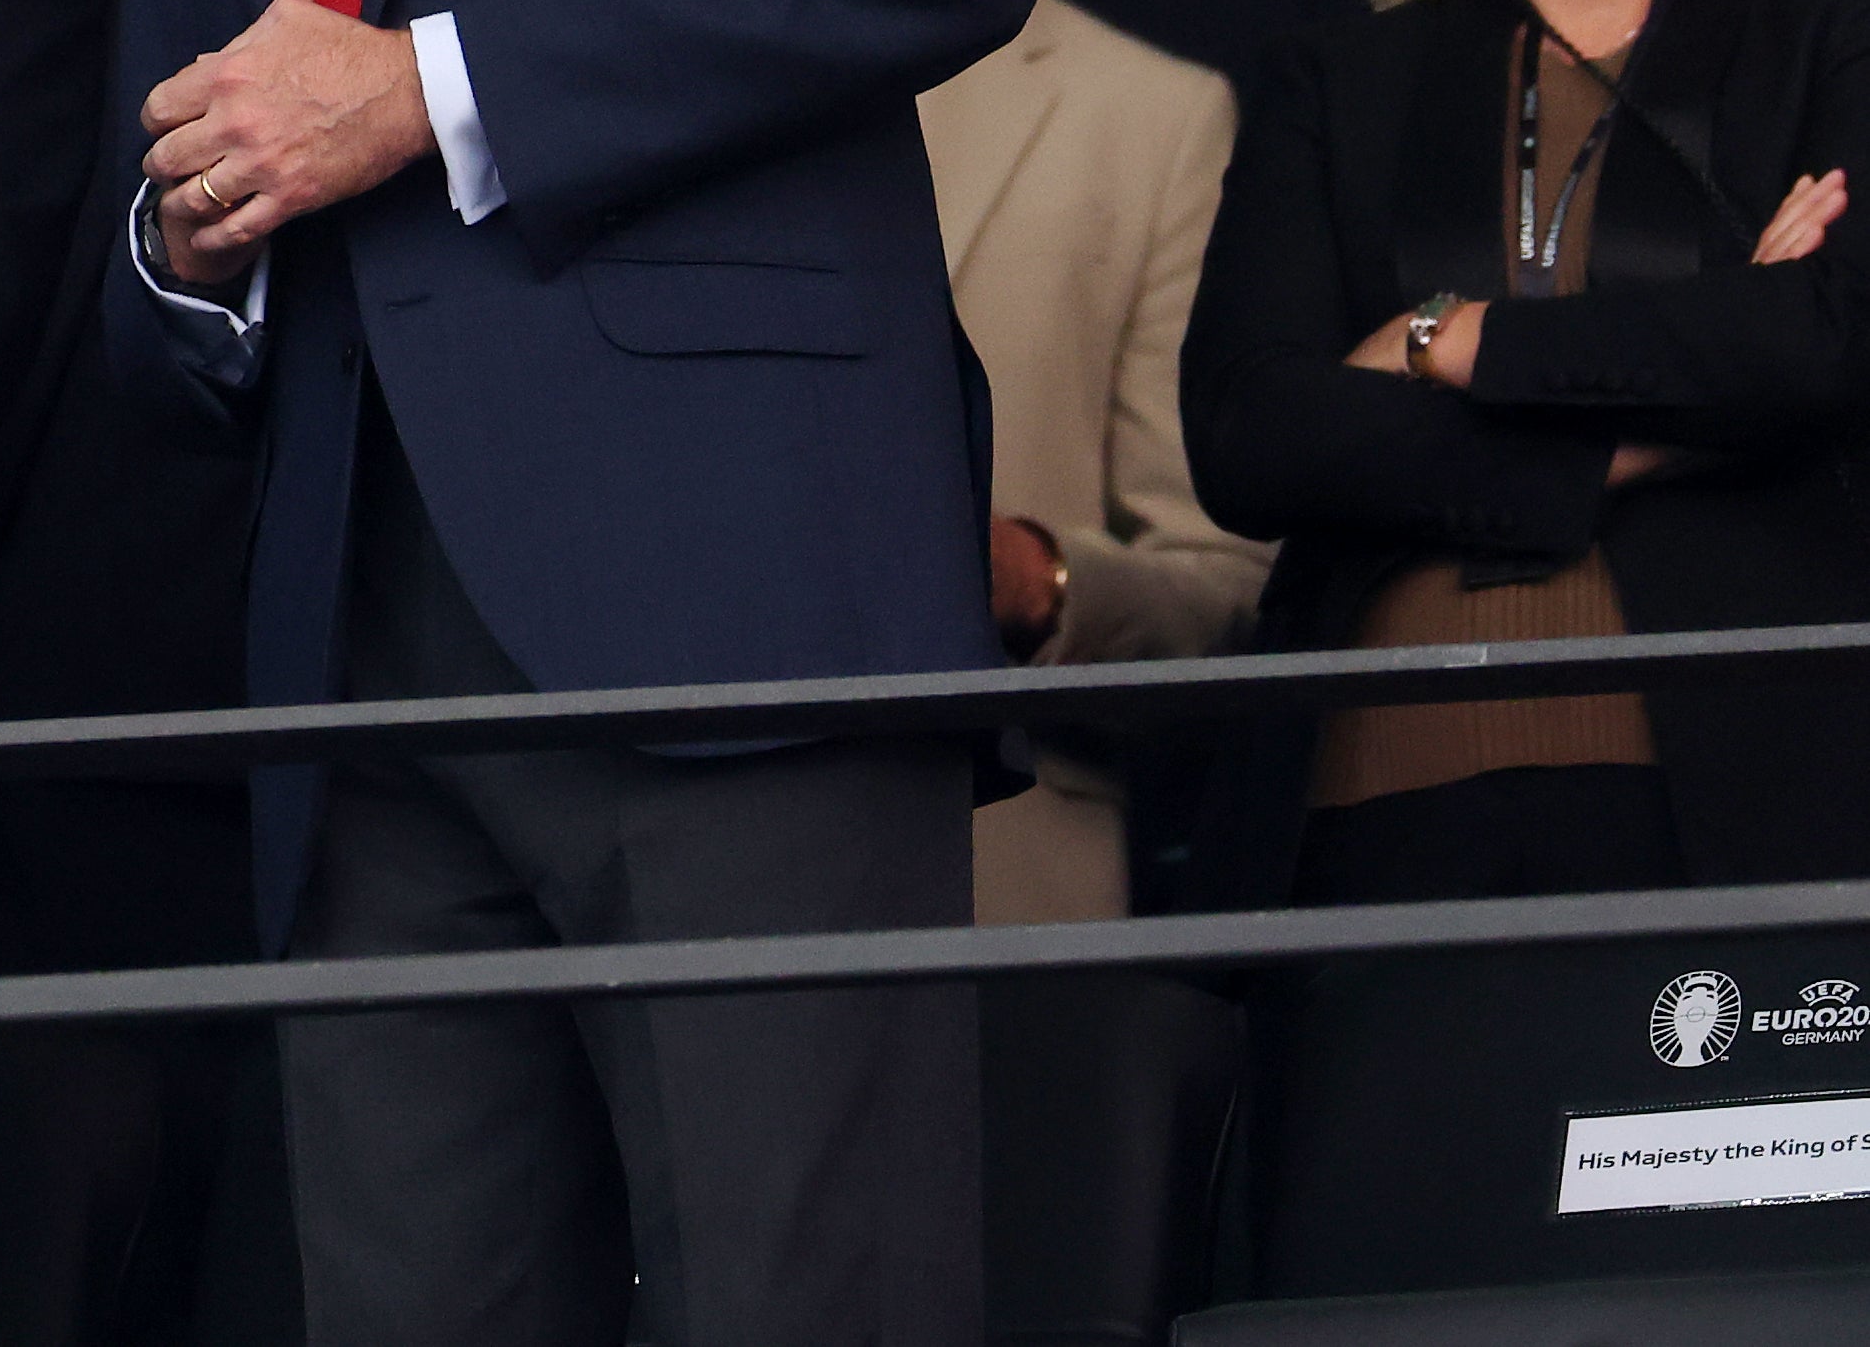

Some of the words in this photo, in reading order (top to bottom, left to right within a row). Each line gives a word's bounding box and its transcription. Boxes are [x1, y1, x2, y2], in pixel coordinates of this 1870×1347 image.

[1801, 983, 1854, 1002] UEFA
[1751, 1005, 1870, 1032] EURO20
[1781, 1029, 1865, 1045] GERMANY
[1578, 1153, 1615, 1170] His
[1621, 1146, 1719, 1169] Majesty
[1723, 1142, 1765, 1160] the
[1770, 1137, 1825, 1158] King
[1830, 1134, 1857, 1153] of
